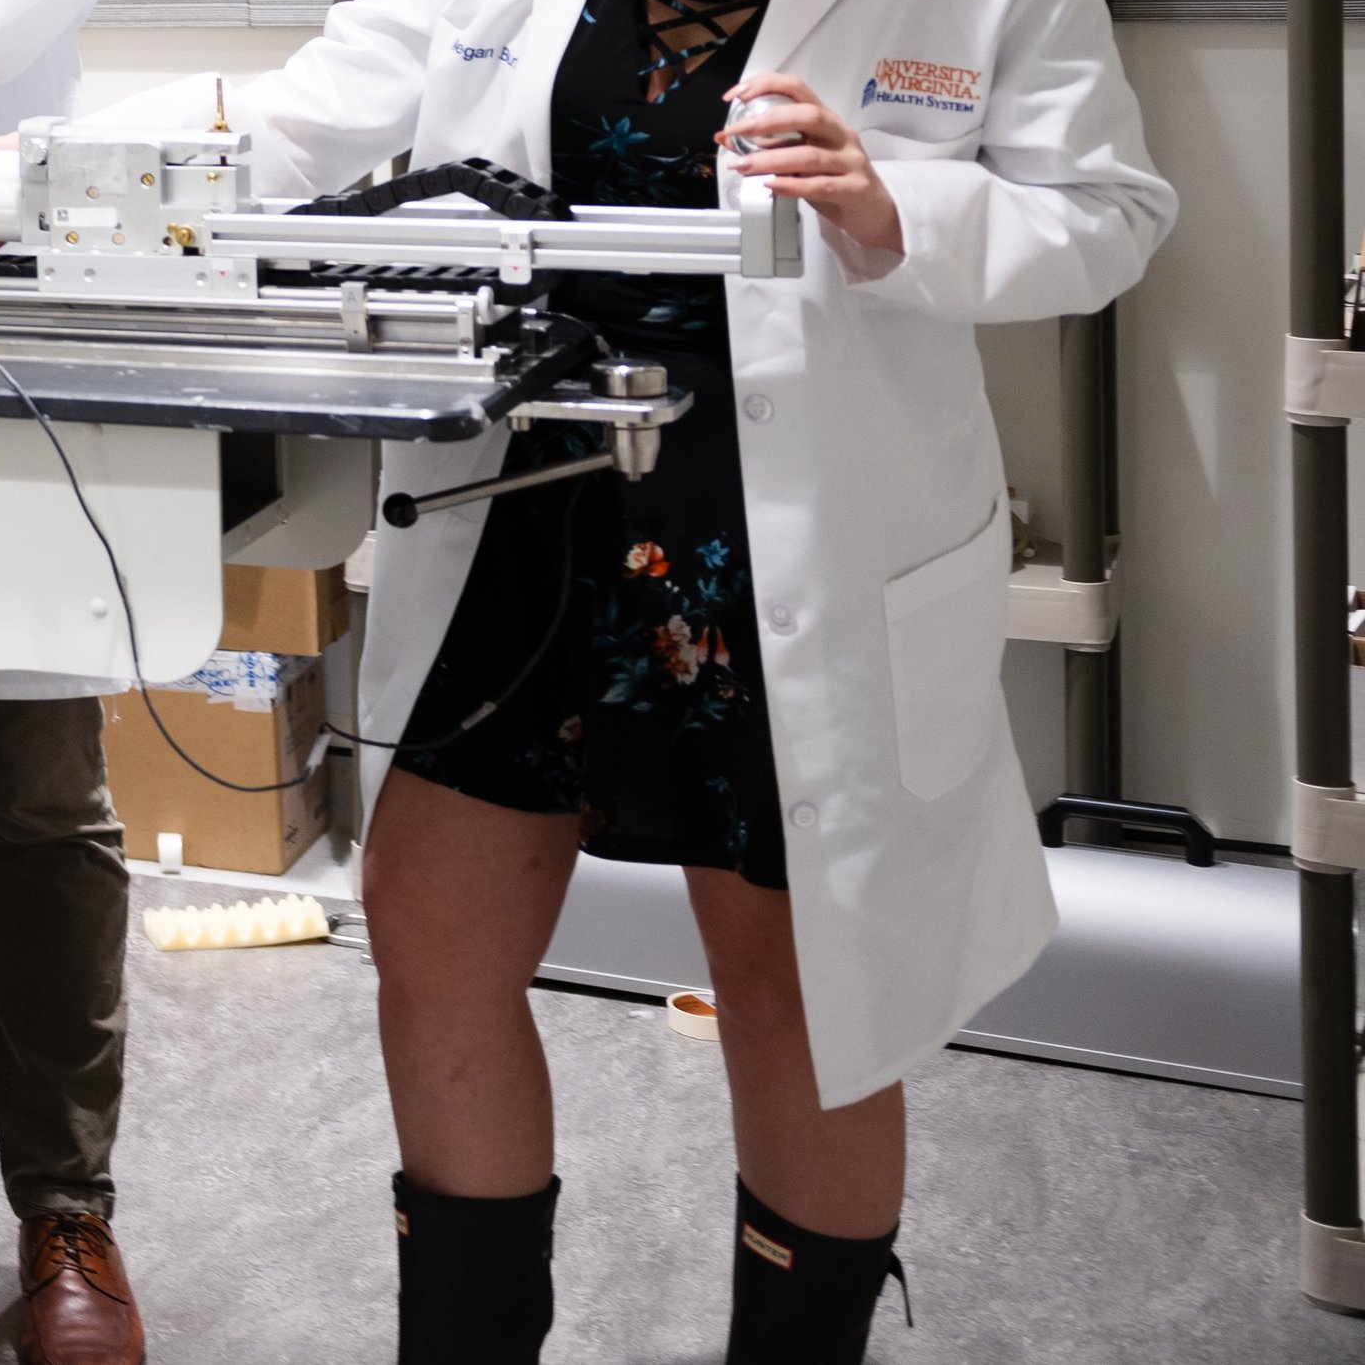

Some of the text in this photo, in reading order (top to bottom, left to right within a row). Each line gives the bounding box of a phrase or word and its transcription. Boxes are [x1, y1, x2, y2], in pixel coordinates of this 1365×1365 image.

[452, 38, 495, 62] egan
[876, 58, 981, 85] UNIVERSITY
[877, 90, 974, 112] HEALTH SYSTEM
